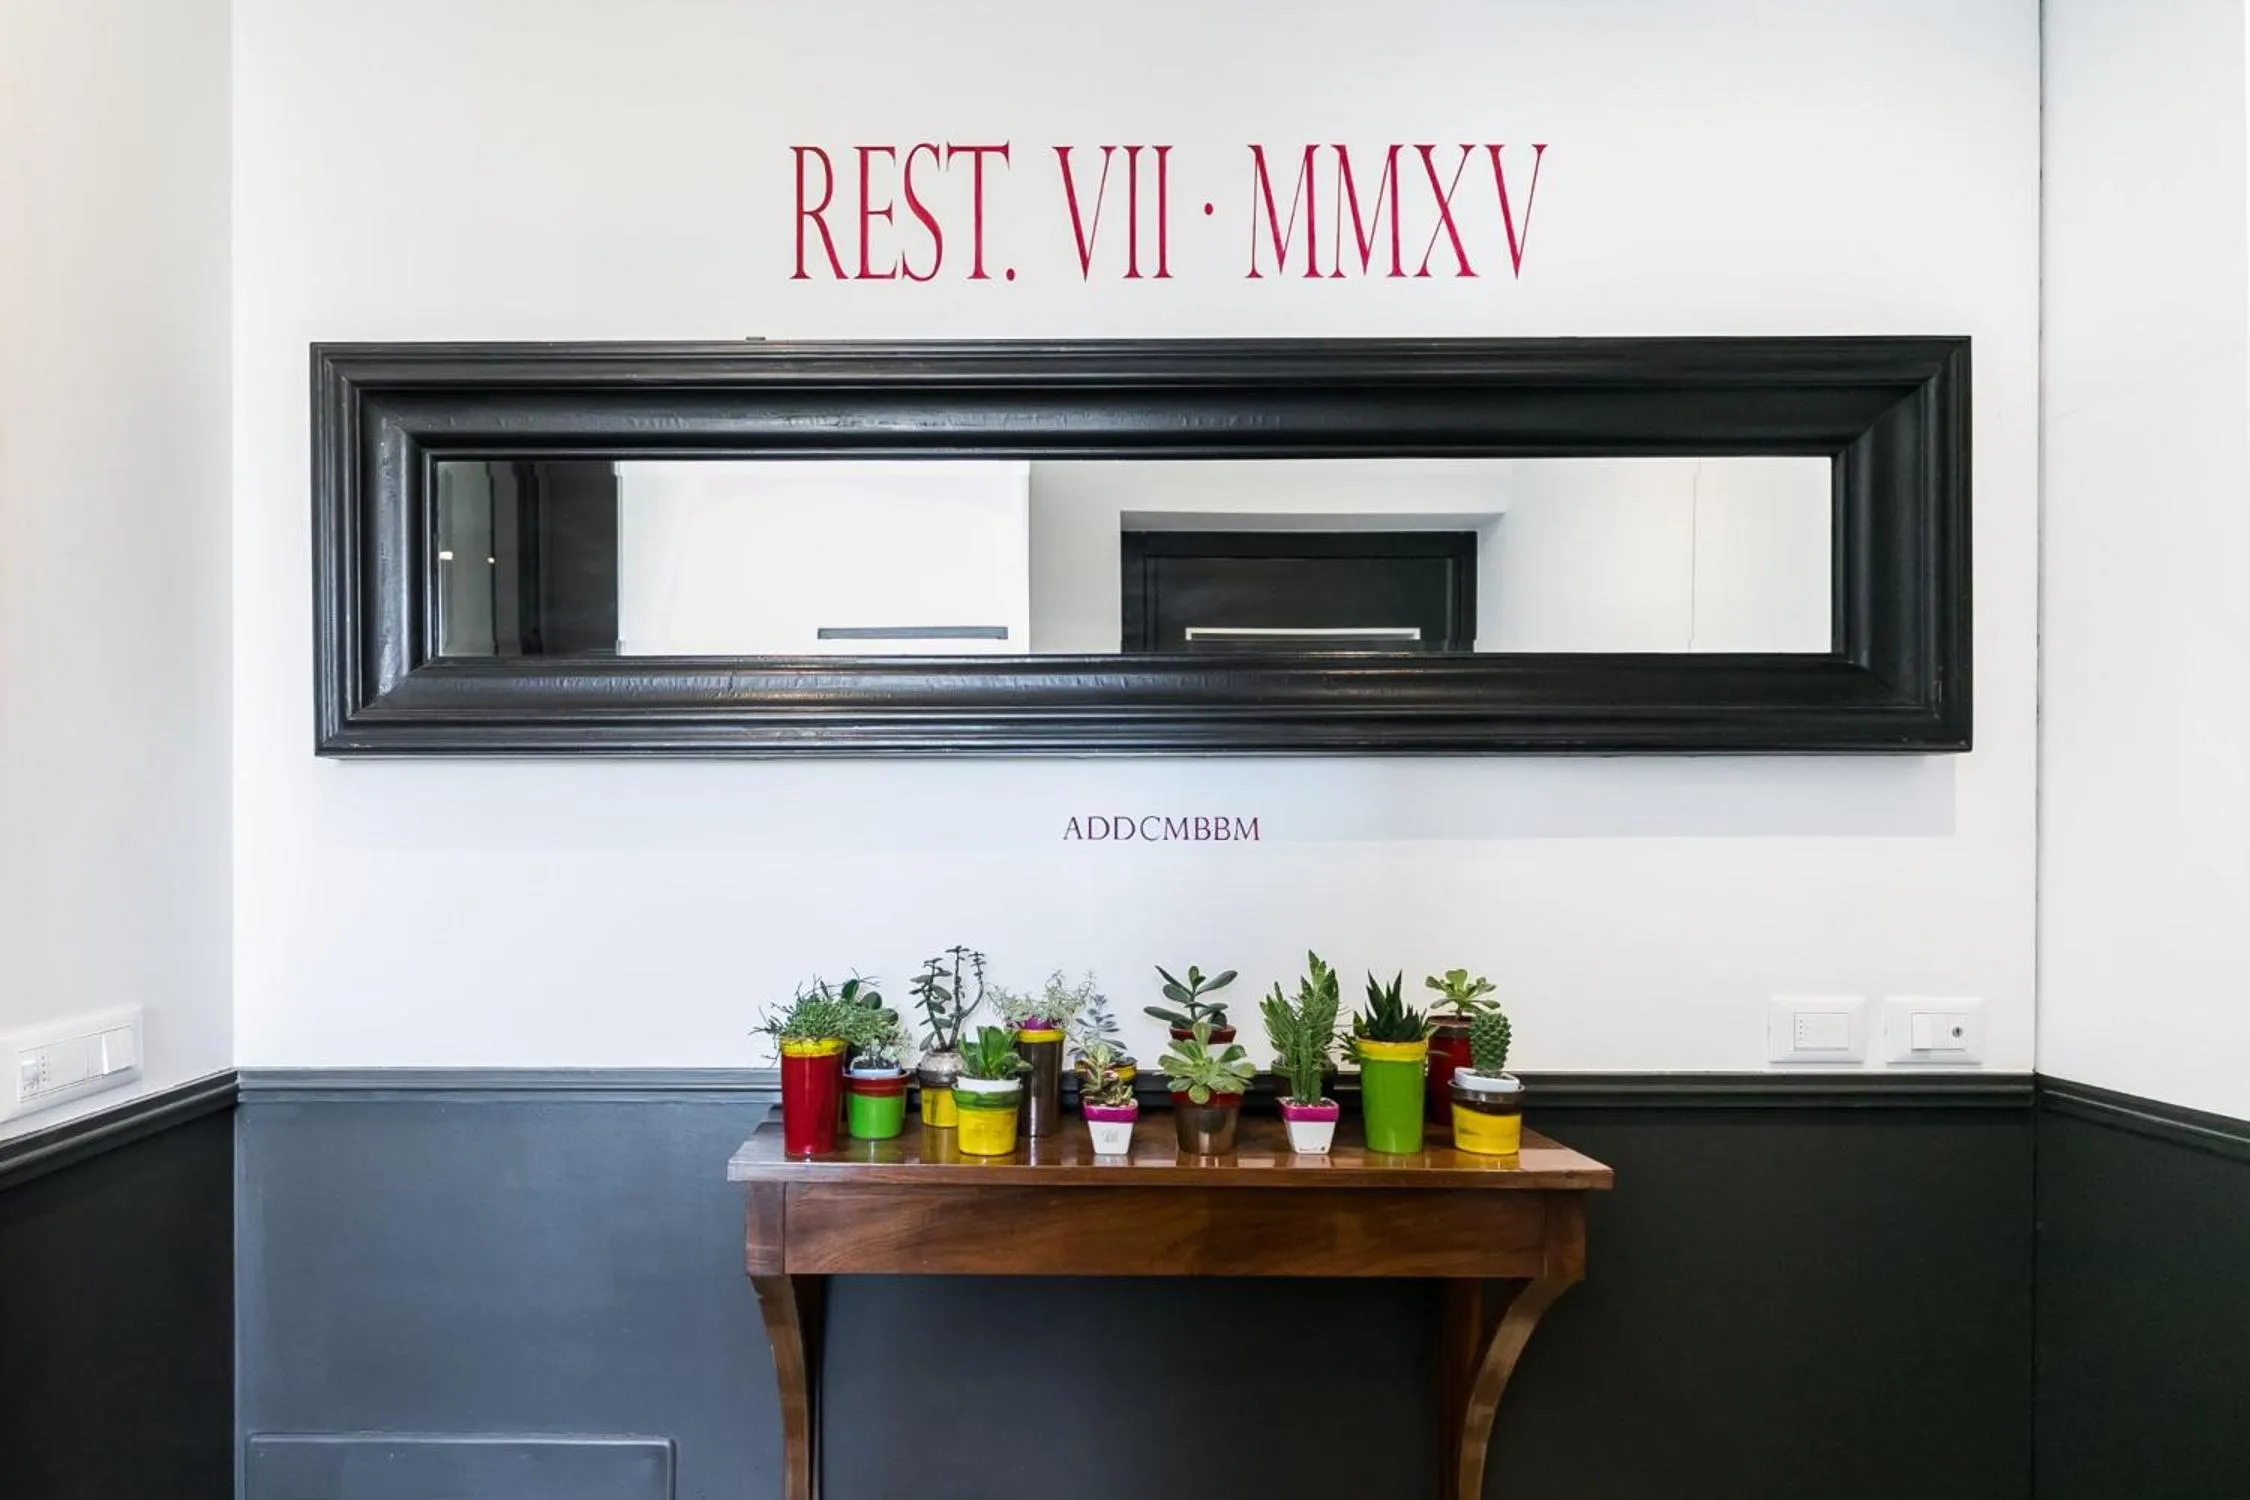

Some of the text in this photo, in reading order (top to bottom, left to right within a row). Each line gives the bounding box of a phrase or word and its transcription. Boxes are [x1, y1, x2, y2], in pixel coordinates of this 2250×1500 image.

[790, 142, 1017, 281] REST.
[1052, 144, 1173, 280] VII
[1248, 143, 1547, 279] MMXV
[1063, 815, 1260, 842] ADDCMBBM
